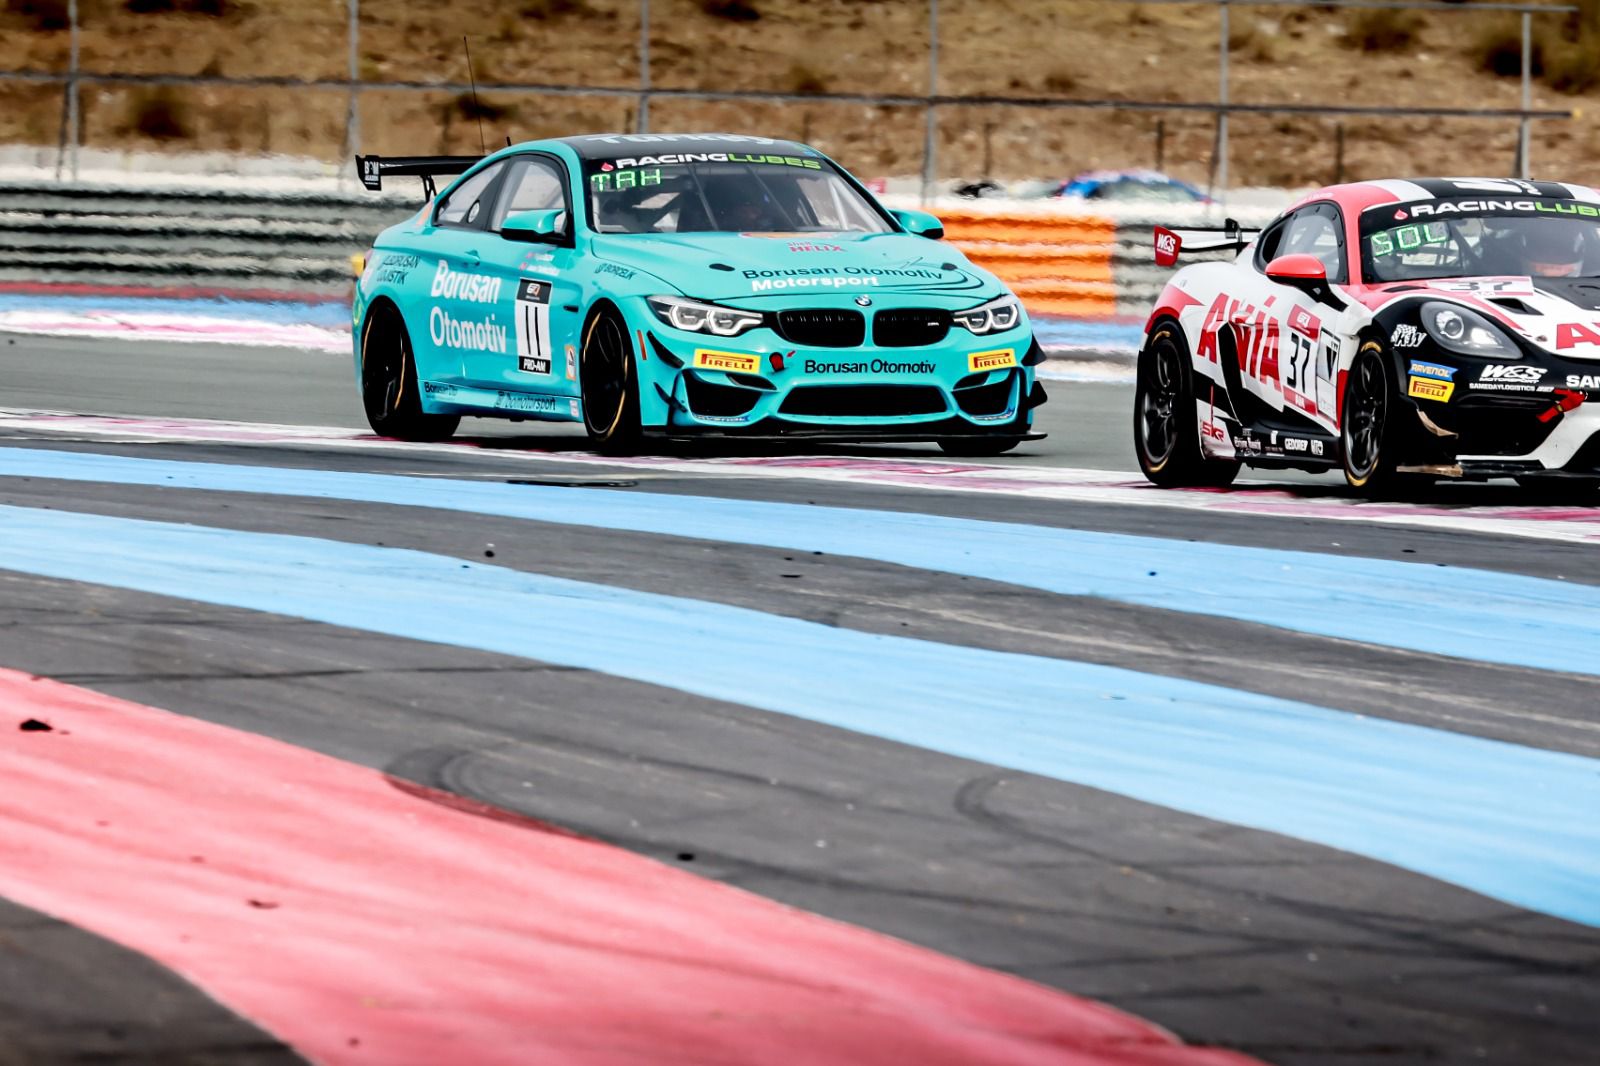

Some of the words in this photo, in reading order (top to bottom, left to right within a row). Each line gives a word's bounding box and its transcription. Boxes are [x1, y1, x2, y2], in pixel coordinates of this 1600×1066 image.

[590, 168, 662, 192] TAH
[1410, 200, 1600, 217] RACINGLUB
[1371, 223, 1448, 257] SOL
[431, 259, 501, 305] Borusan
[742, 266, 838, 279] Borusan
[844, 265, 943, 281] Otomotiv
[751, 275, 880, 292] Motorsport
[429, 306, 506, 354] Otomotiv
[525, 305, 541, 356] 11
[1556, 322, 1600, 350] A
[701, 353, 754, 371] PIRELLI
[804, 360, 868, 374] Borusan
[870, 359, 937, 374] Otomotiv
[973, 352, 1013, 369] PIRELLI
[1287, 332, 1311, 394] 37
[1480, 364, 1548, 380] W&S
[1413, 380, 1448, 398] PIRELLI
